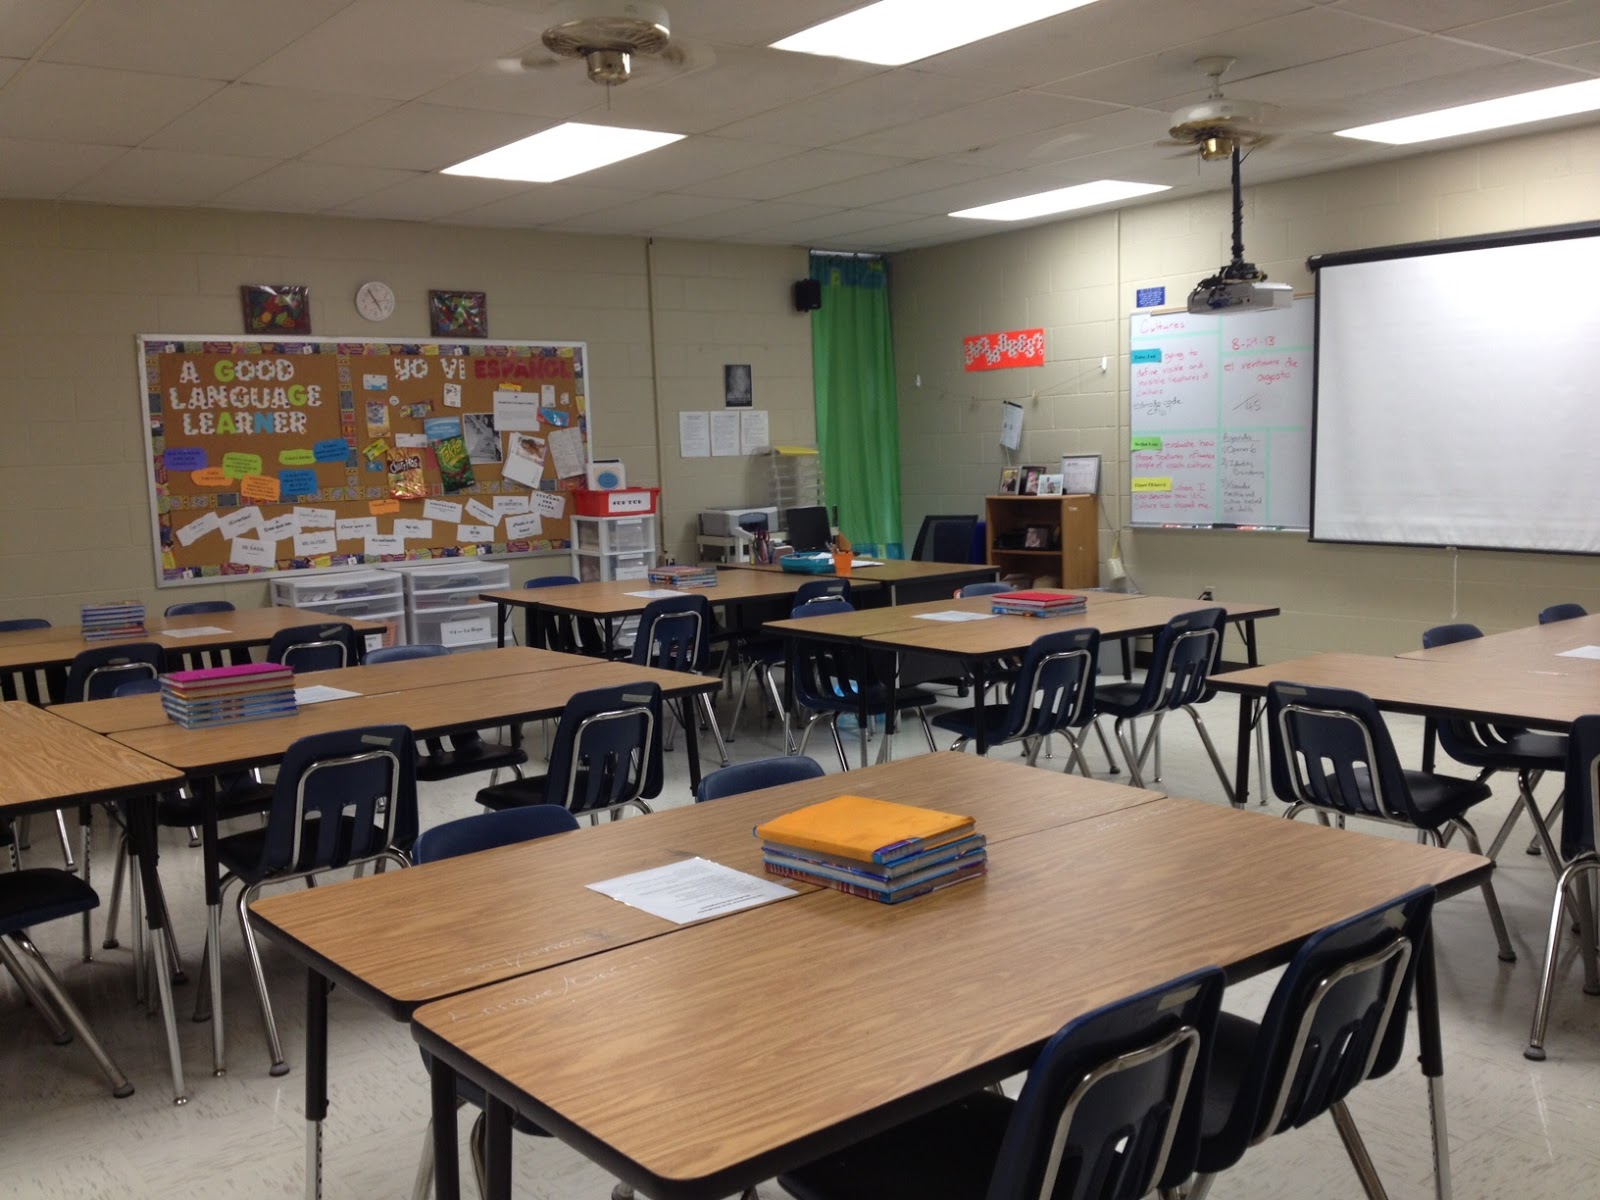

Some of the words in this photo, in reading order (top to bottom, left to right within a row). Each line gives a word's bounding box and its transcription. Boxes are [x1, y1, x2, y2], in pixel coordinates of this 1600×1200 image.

[179, 361, 200, 383] A
[213, 359, 294, 382] GOOD
[440, 358, 466, 379] VI
[169, 384, 322, 409] LANGUAGE
[183, 411, 307, 435] LEARNER
